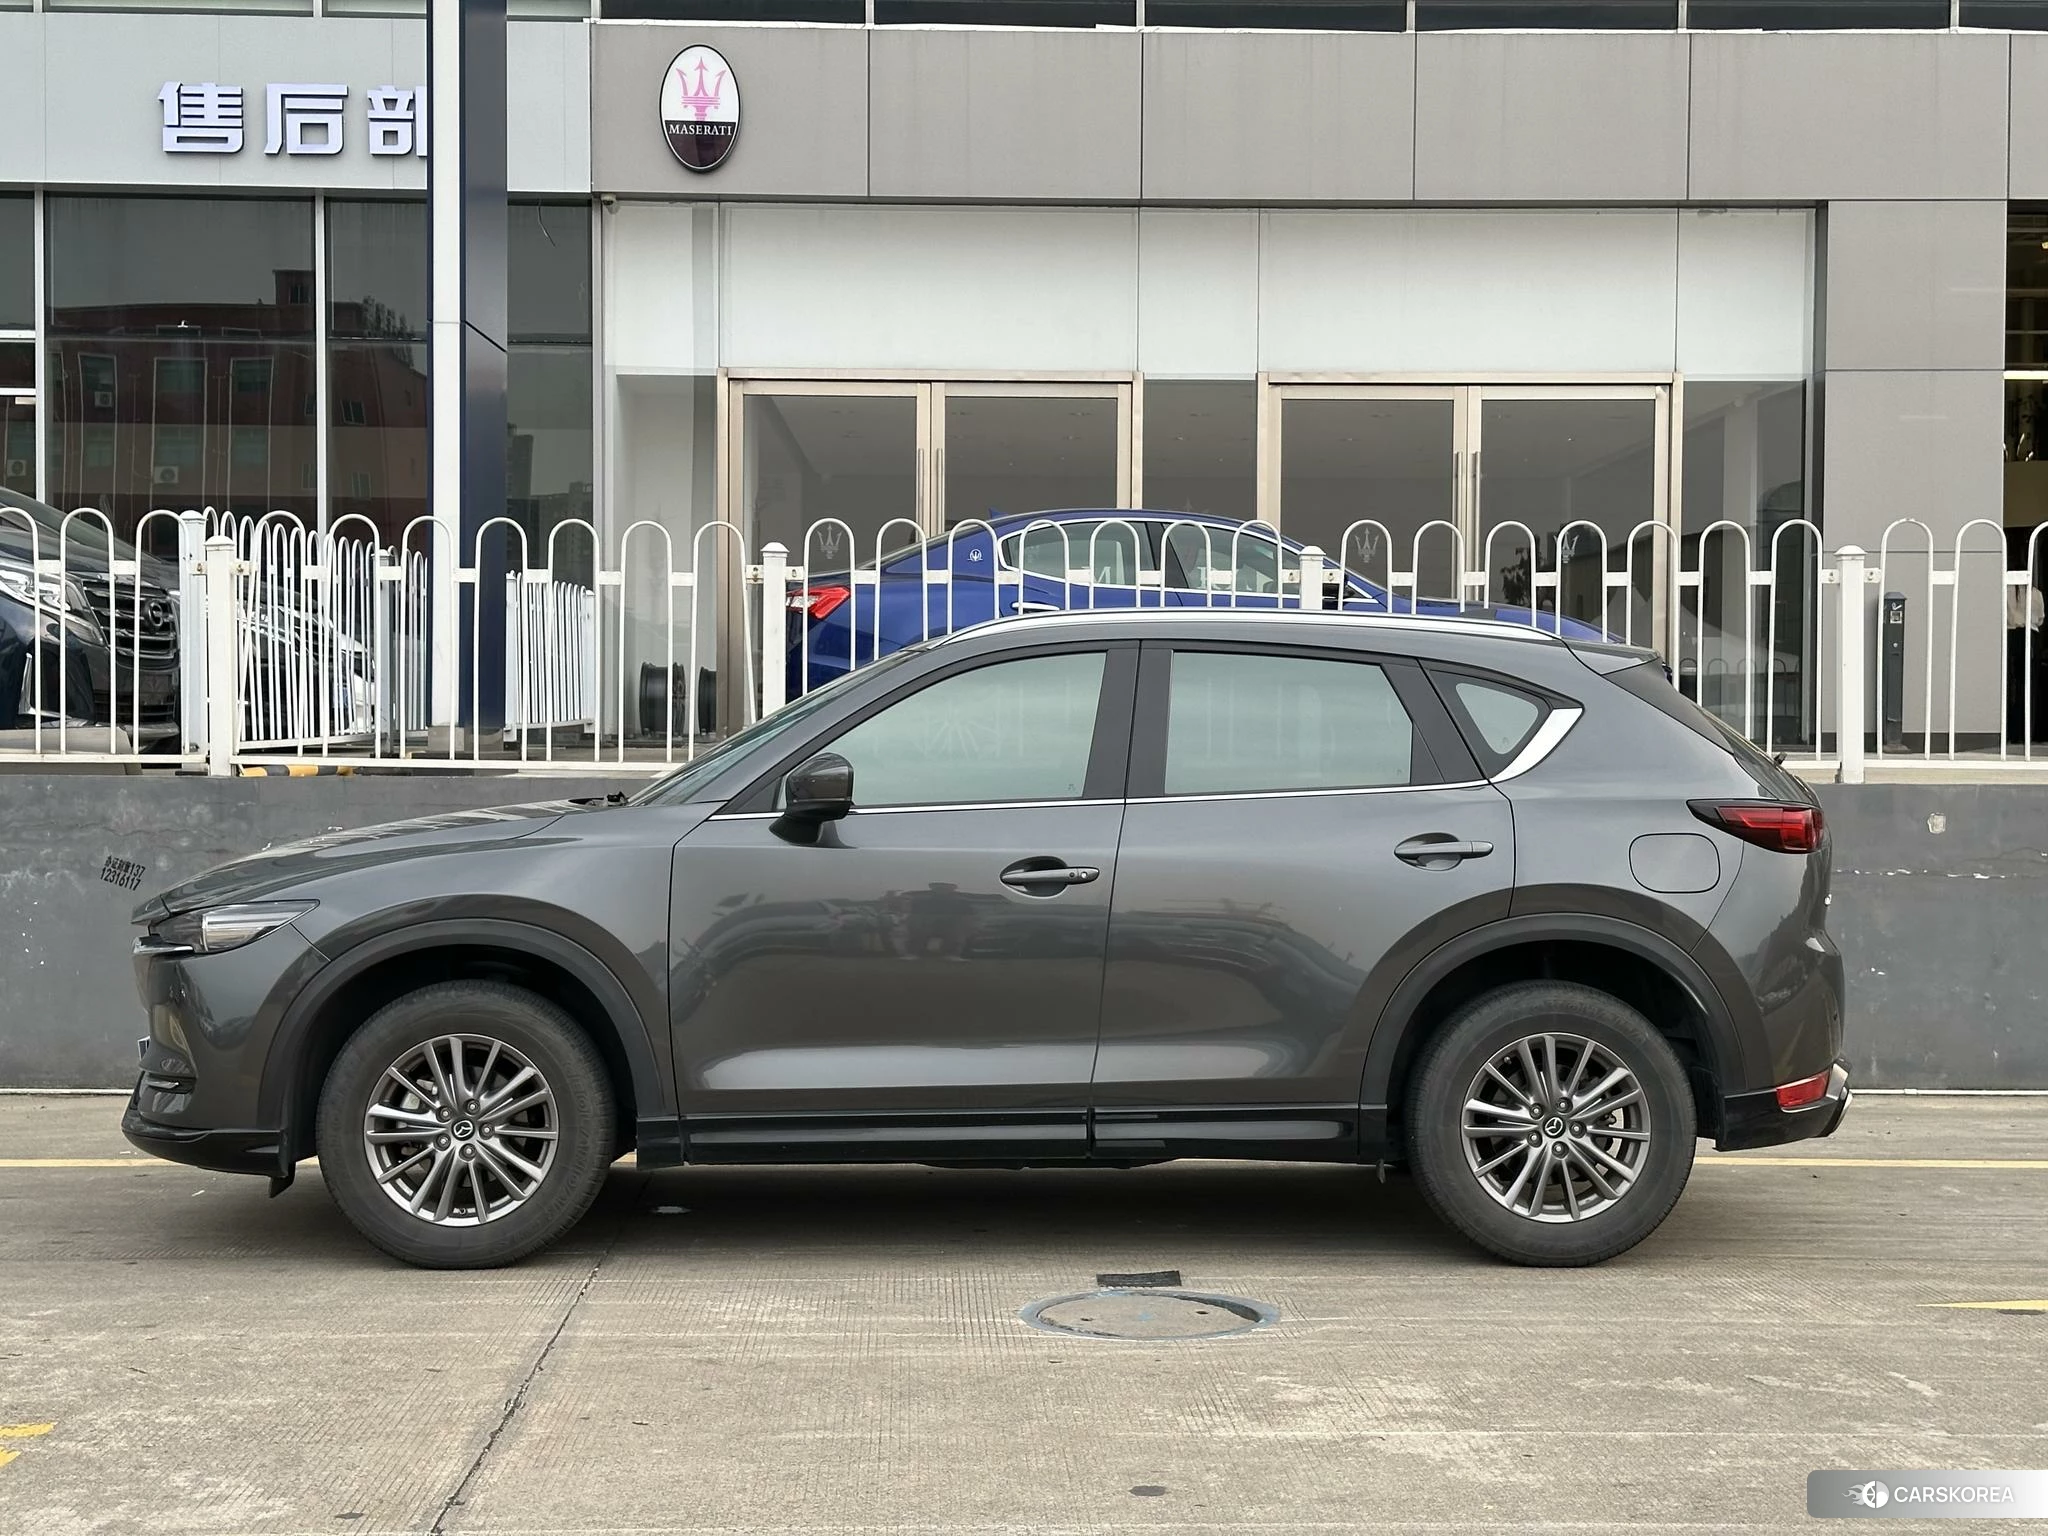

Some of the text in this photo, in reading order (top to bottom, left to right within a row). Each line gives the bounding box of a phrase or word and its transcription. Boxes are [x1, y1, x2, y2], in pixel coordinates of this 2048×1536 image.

[157, 81, 428, 158] 售后部
[668, 123, 733, 136] MASERATI
[100, 867, 142, 891] 12316117
